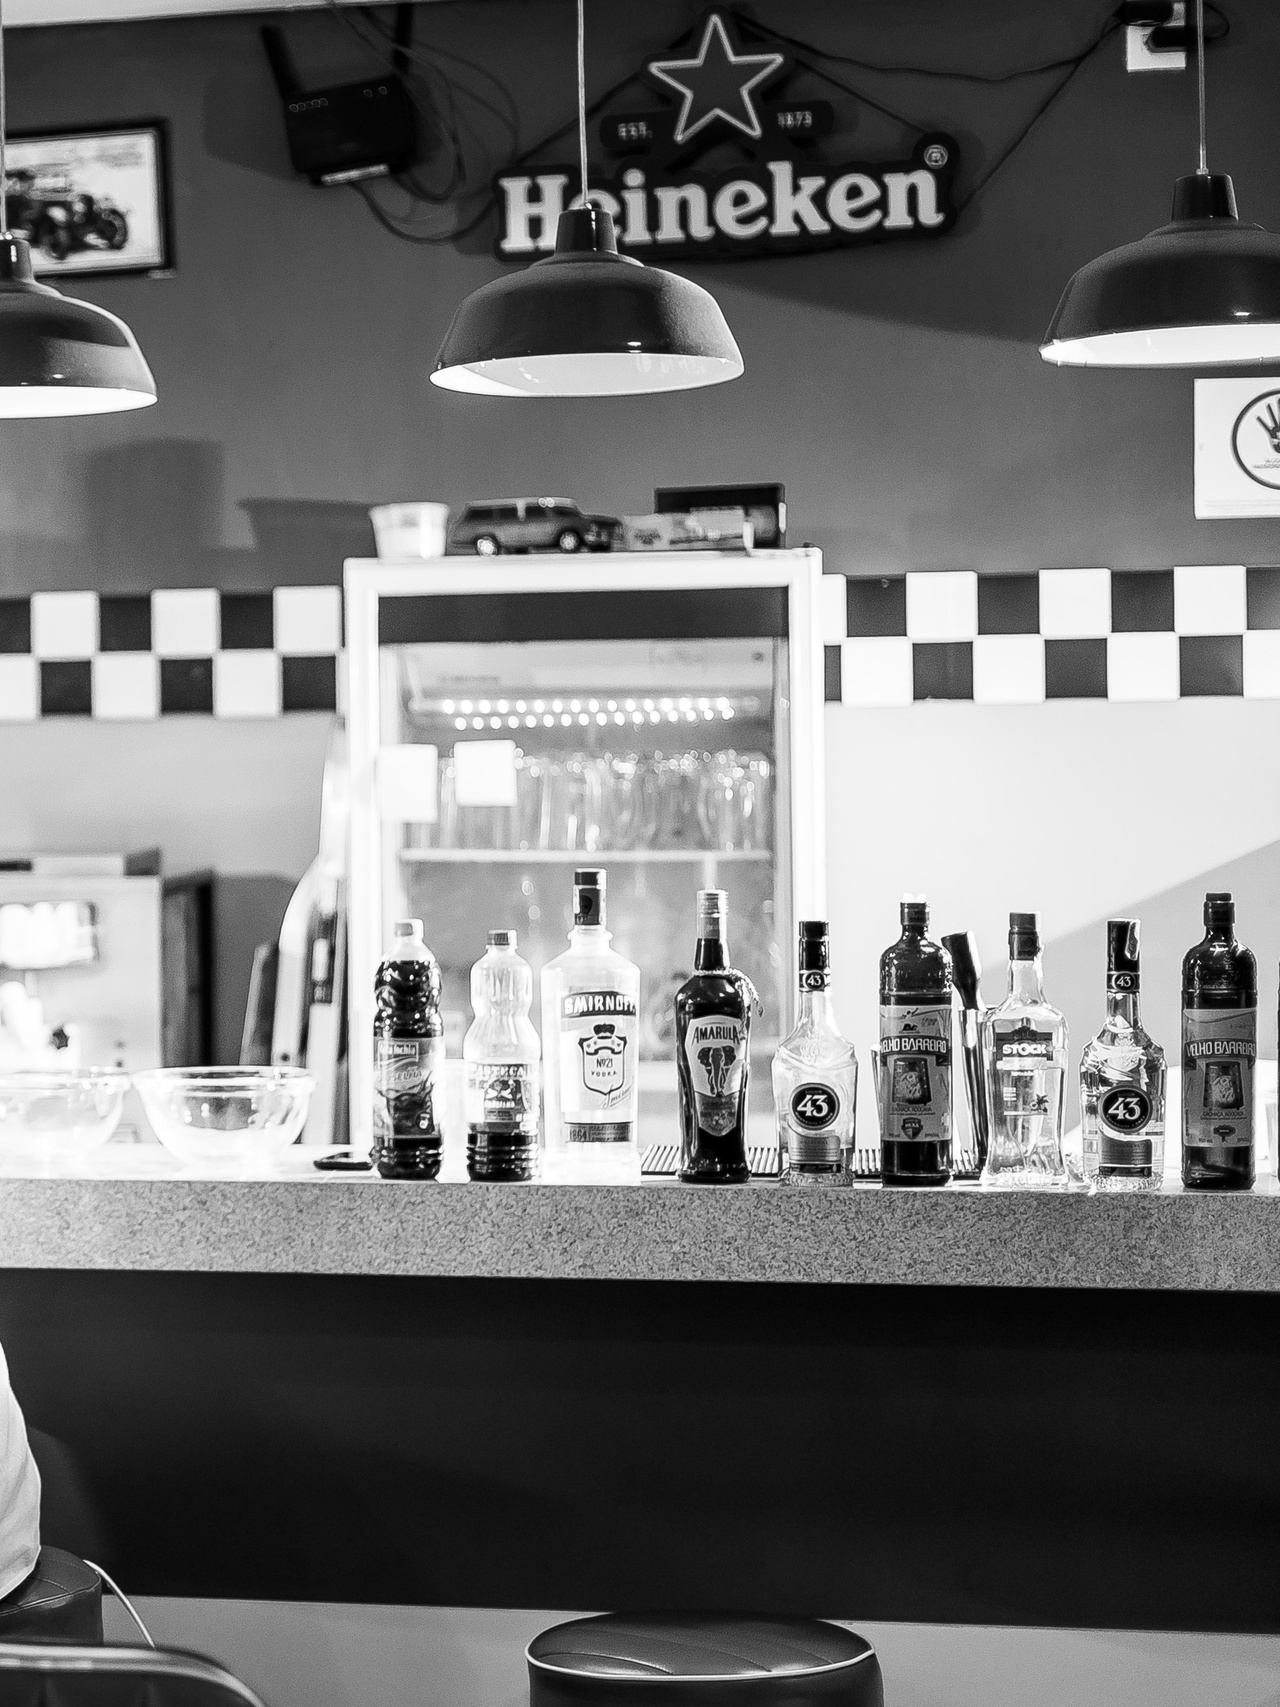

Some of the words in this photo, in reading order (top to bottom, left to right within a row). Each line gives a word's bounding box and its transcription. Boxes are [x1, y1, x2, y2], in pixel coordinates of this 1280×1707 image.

[806, 974, 823, 987] 43
[1116, 975, 1132, 988] 43
[692, 1024, 741, 1045] AMARULA
[901, 1037, 947, 1054] BARREIRO
[1002, 1042, 1048, 1056] STOCK
[1186, 1041, 1213, 1057] VELHO
[1214, 1041, 1256, 1057] BARREIRO
[796, 1094, 829, 1118] 43
[1107, 1097, 1141, 1120] 43
